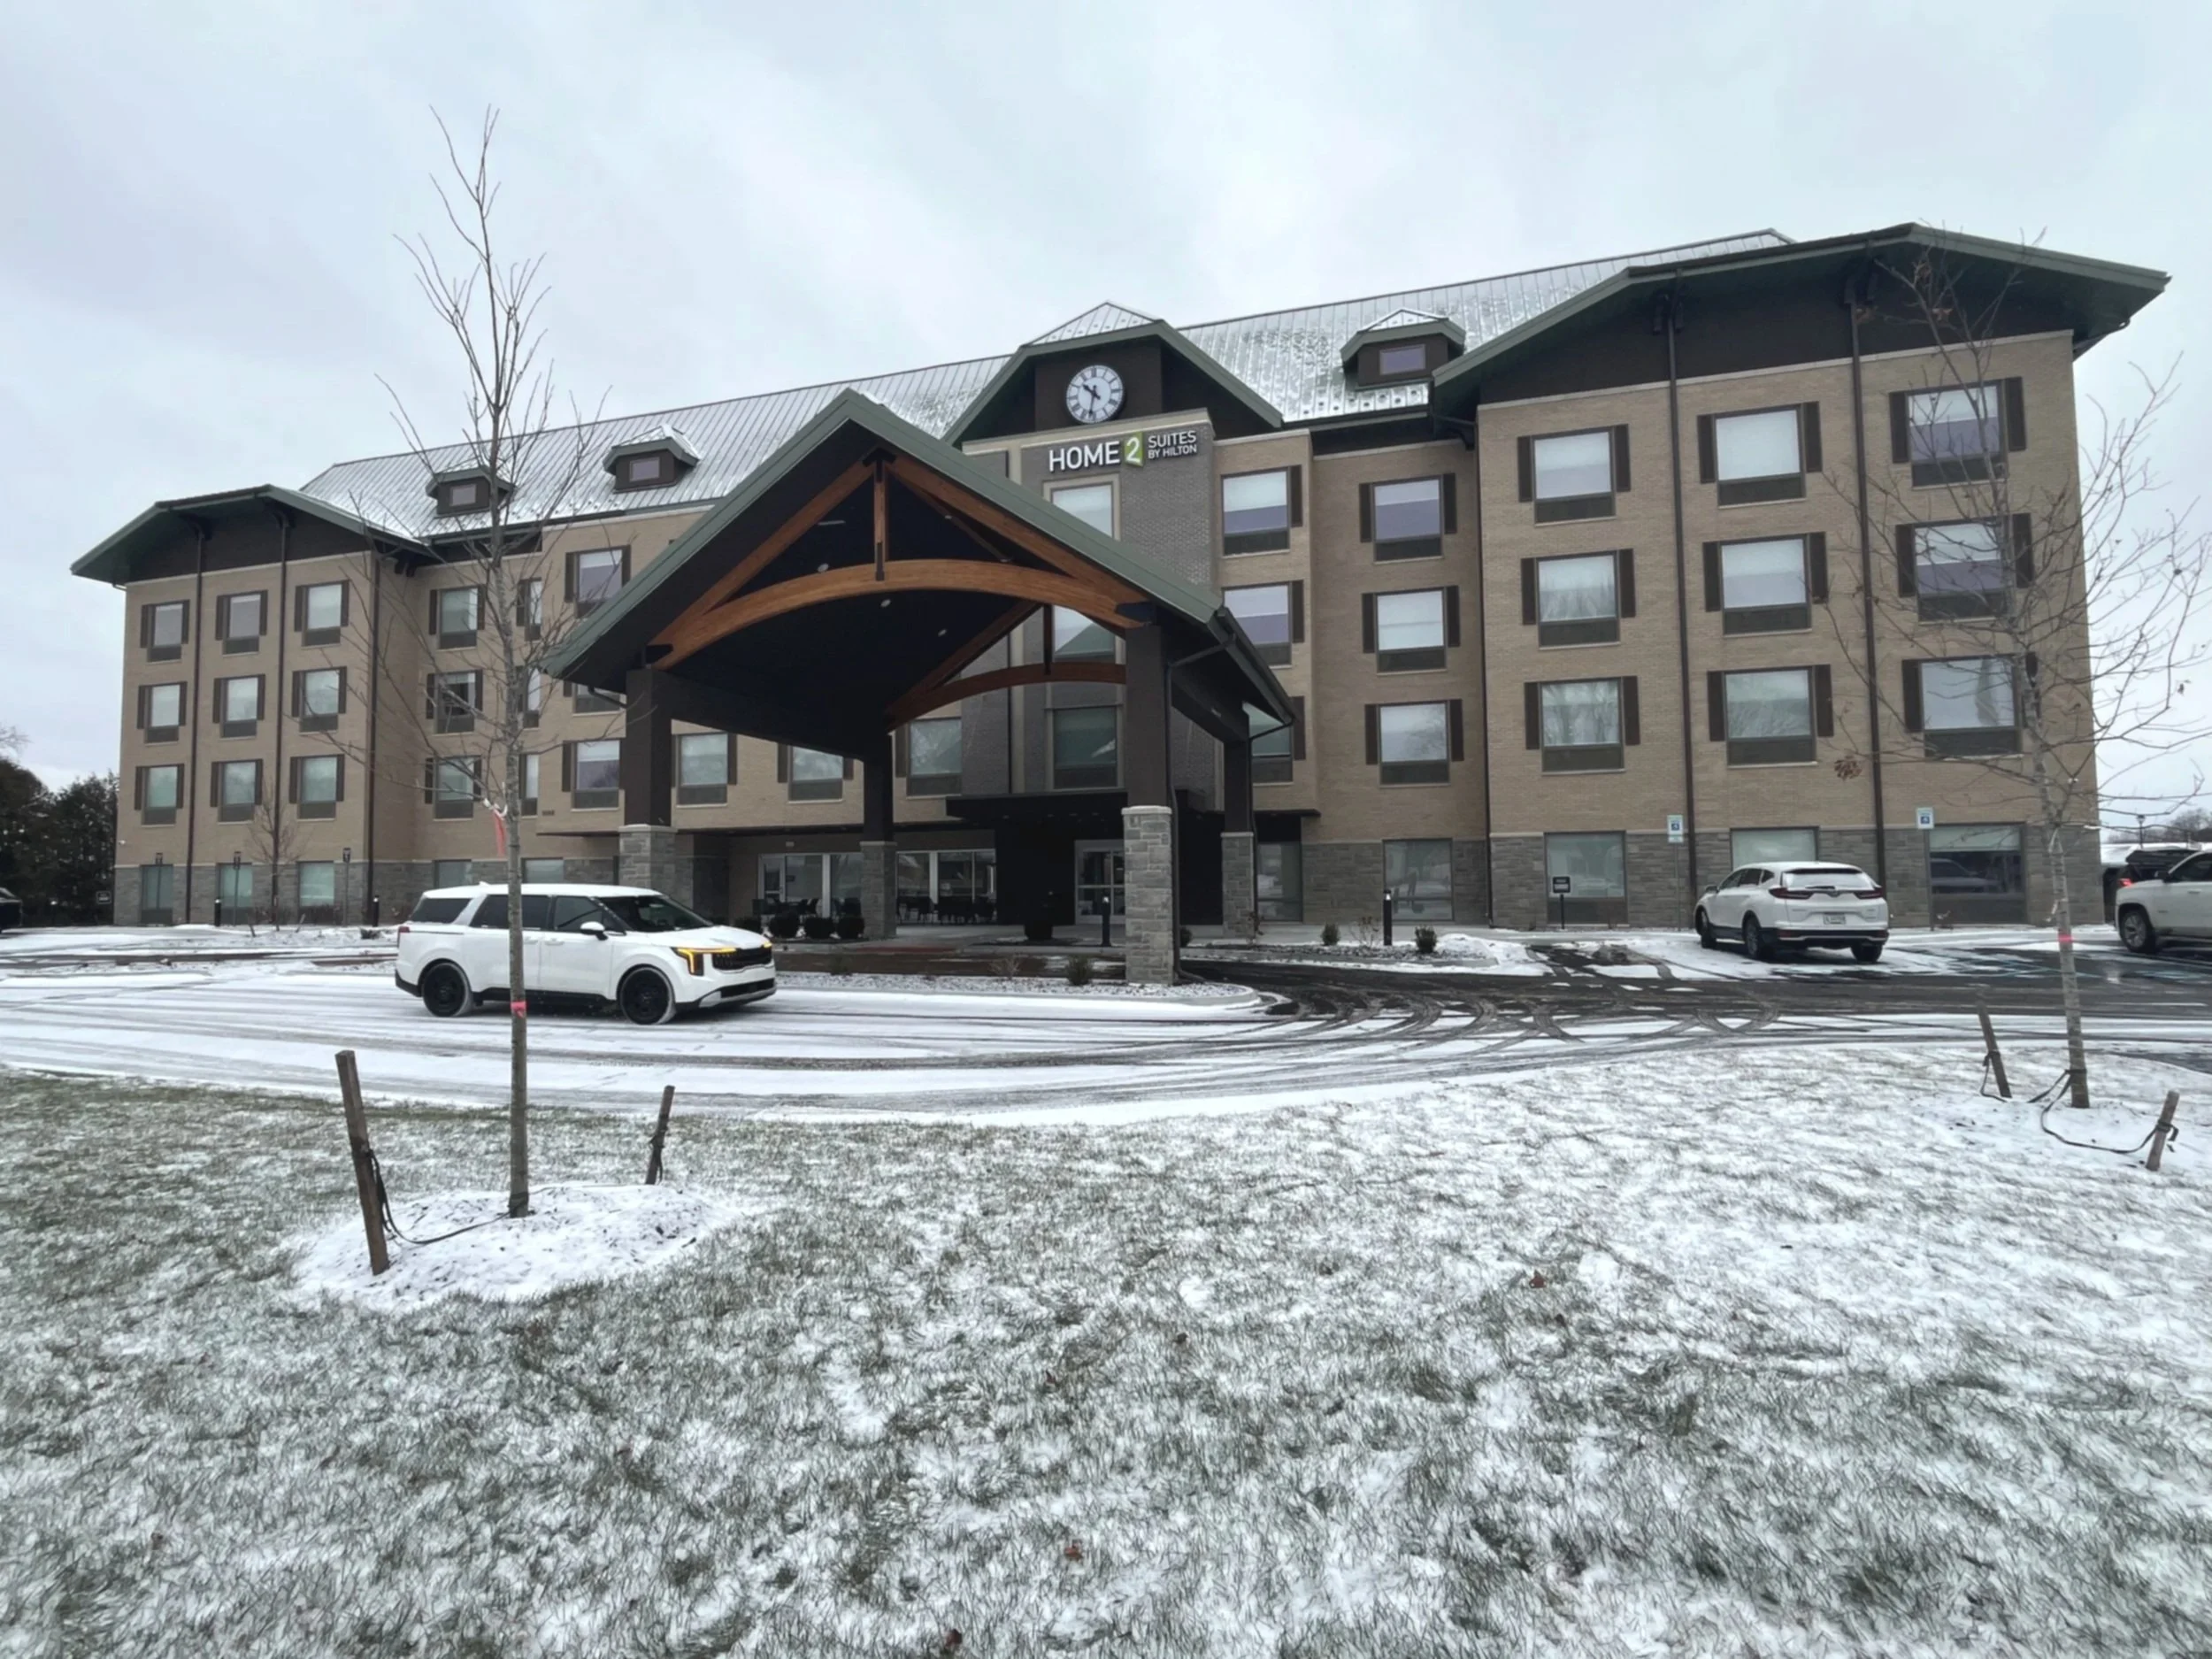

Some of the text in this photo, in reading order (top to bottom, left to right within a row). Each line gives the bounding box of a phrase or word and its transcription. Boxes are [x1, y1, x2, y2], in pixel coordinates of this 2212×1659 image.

[1148, 430, 1197, 449] SUITES
[1048, 437, 1141, 472] HOME 2
[1148, 444, 1197, 459] BY HILTON
